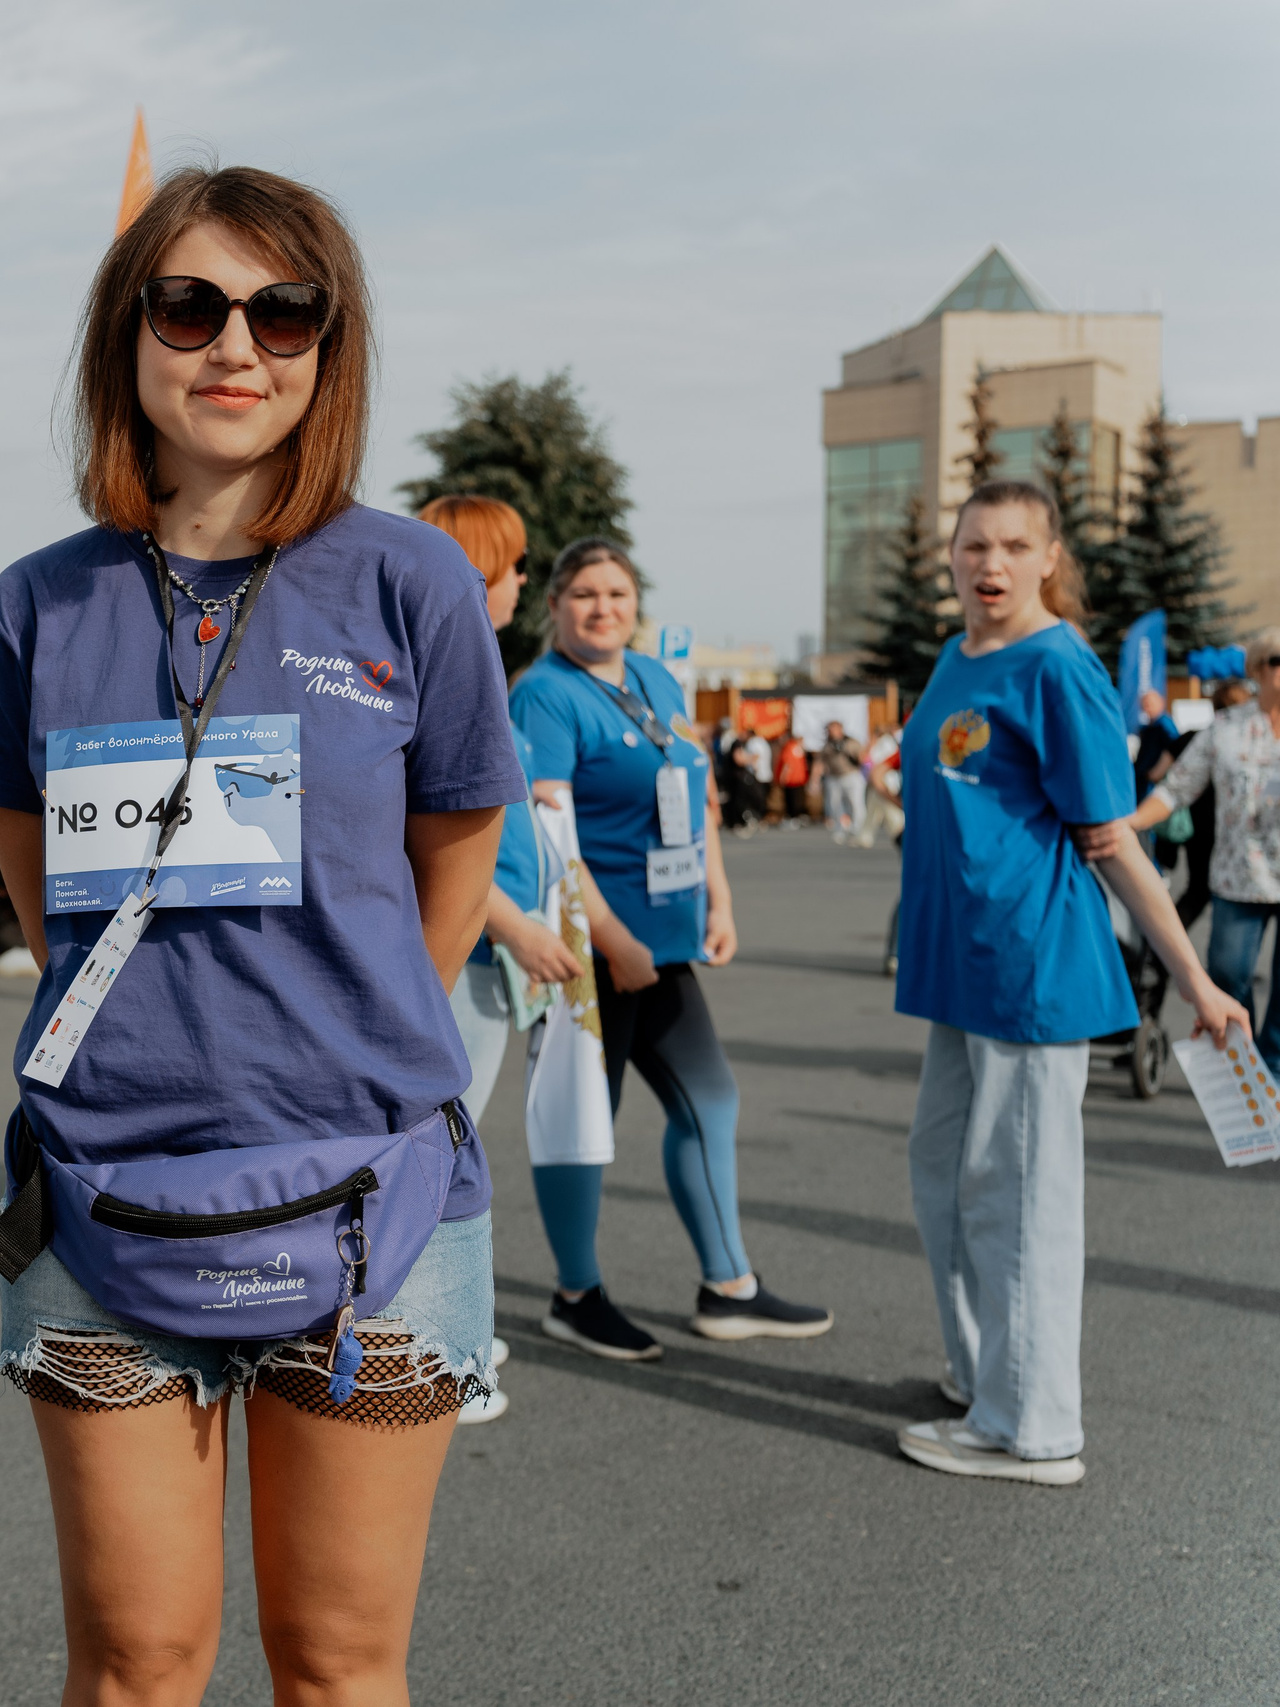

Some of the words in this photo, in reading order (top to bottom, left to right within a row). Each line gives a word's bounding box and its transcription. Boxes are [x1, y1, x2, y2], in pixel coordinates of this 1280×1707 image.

[280, 648, 354, 676] Родные
[305, 673, 394, 713] Любимые
[75, 740, 105, 752] Забег
[108, 732, 184, 749] волонтёров
[200, 731, 238, 742] жного
[241, 729, 279, 741] Урала
[58, 802, 98, 835] №
[55, 879, 75, 888] Беги.
[55, 888, 90, 898] Помогай.
[55, 897, 103, 909] Вдохновляй.
[196, 1267, 258, 1284] Родные
[222, 1276, 306, 1299] Любимые
